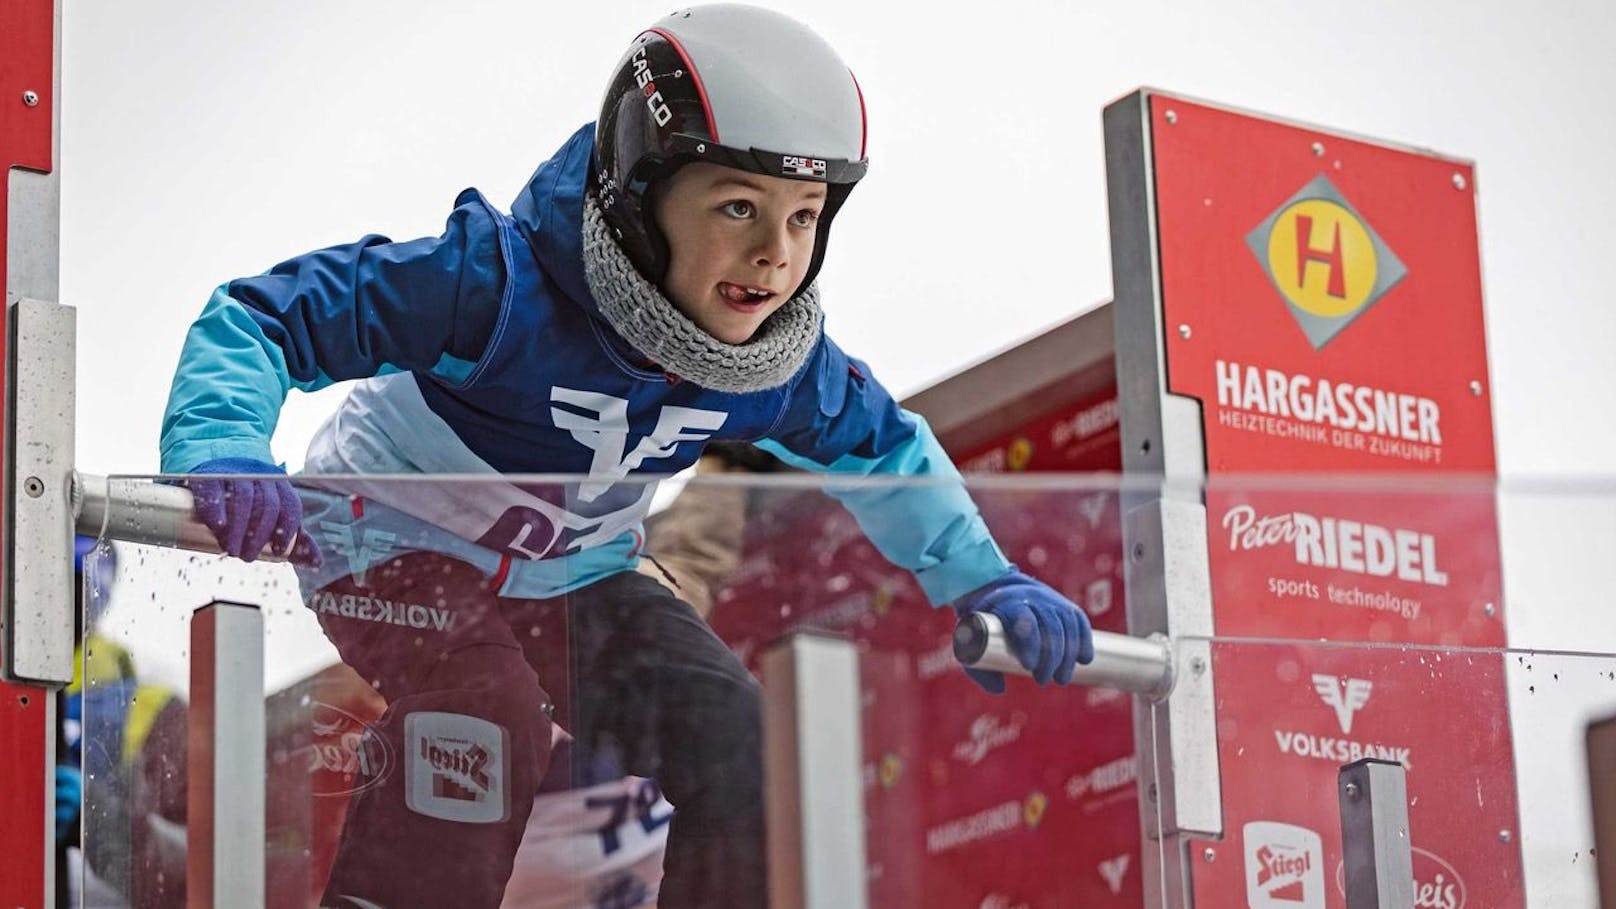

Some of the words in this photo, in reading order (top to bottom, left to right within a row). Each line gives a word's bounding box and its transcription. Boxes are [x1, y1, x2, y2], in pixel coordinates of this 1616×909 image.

[1215, 359, 1442, 445] HARGASSNER
[1218, 410, 1328, 444] HEIZTECHNIK
[1331, 430, 1366, 450] DER
[1369, 436, 1443, 464] ZUKUNFT
[1222, 505, 1299, 551] Peter
[1292, 511, 1448, 586] RIEDEL
[1268, 577, 1320, 600] sports
[1327, 584, 1421, 620] technology
[1256, 845, 1311, 887] Stiegl
